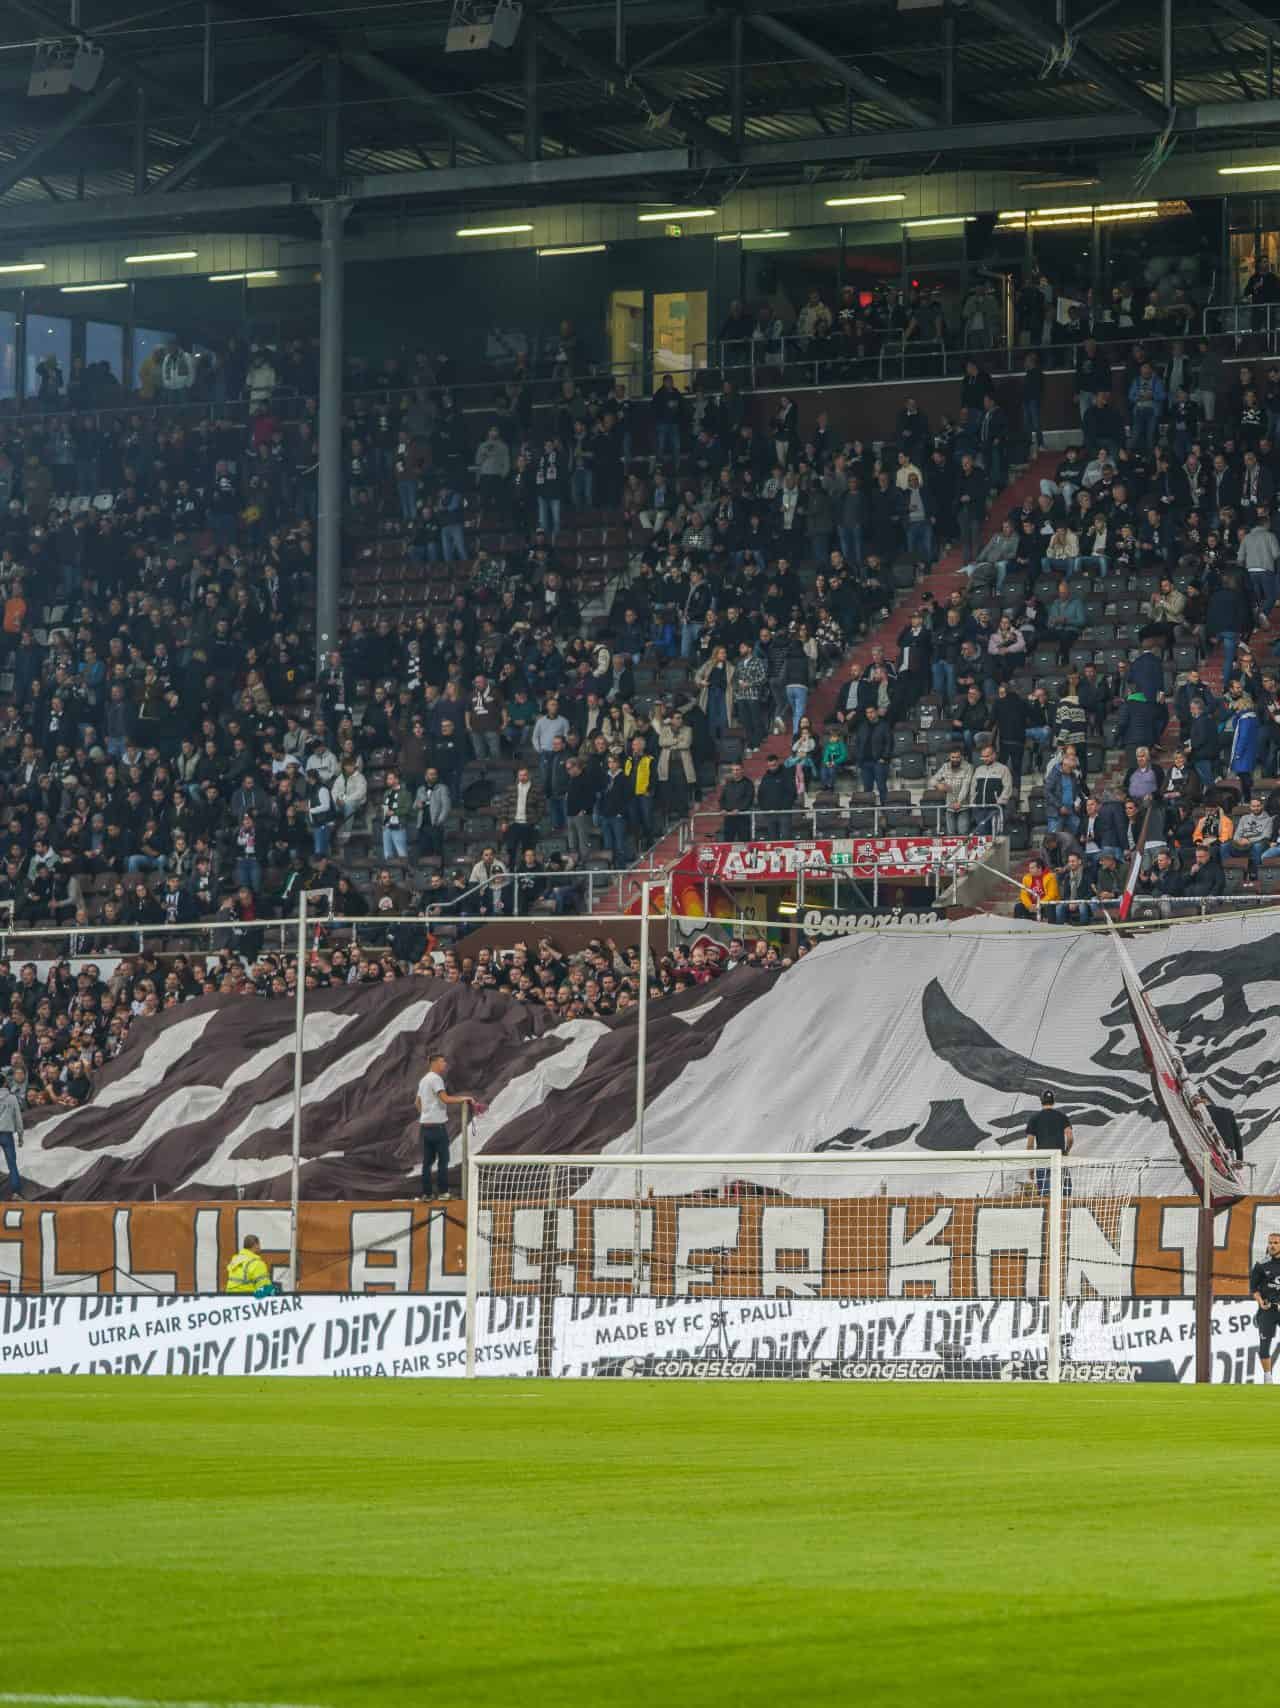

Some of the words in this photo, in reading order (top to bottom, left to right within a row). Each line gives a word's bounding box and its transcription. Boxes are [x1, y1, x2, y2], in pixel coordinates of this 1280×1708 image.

[89, 1323, 140, 1346] ULTRA
[146, 1316, 181, 1337] FAIR
[188, 1296, 304, 1330] SPORTSWEAR
[595, 1321, 649, 1345] MADE
[656, 1317, 677, 1337] BY
[683, 1312, 704, 1332] FC
[740, 1300, 793, 1325] PAULI
[1112, 1326, 1173, 1352] ULTRA
[1179, 1319, 1222, 1341] FAR
[2, 1339, 49, 1361] PAULI
[393, 1356, 430, 1376] FAIR
[654, 1359, 756, 1378] congstar
[842, 1361, 945, 1380] congstar
[1034, 1363, 1143, 1382] cngstar
